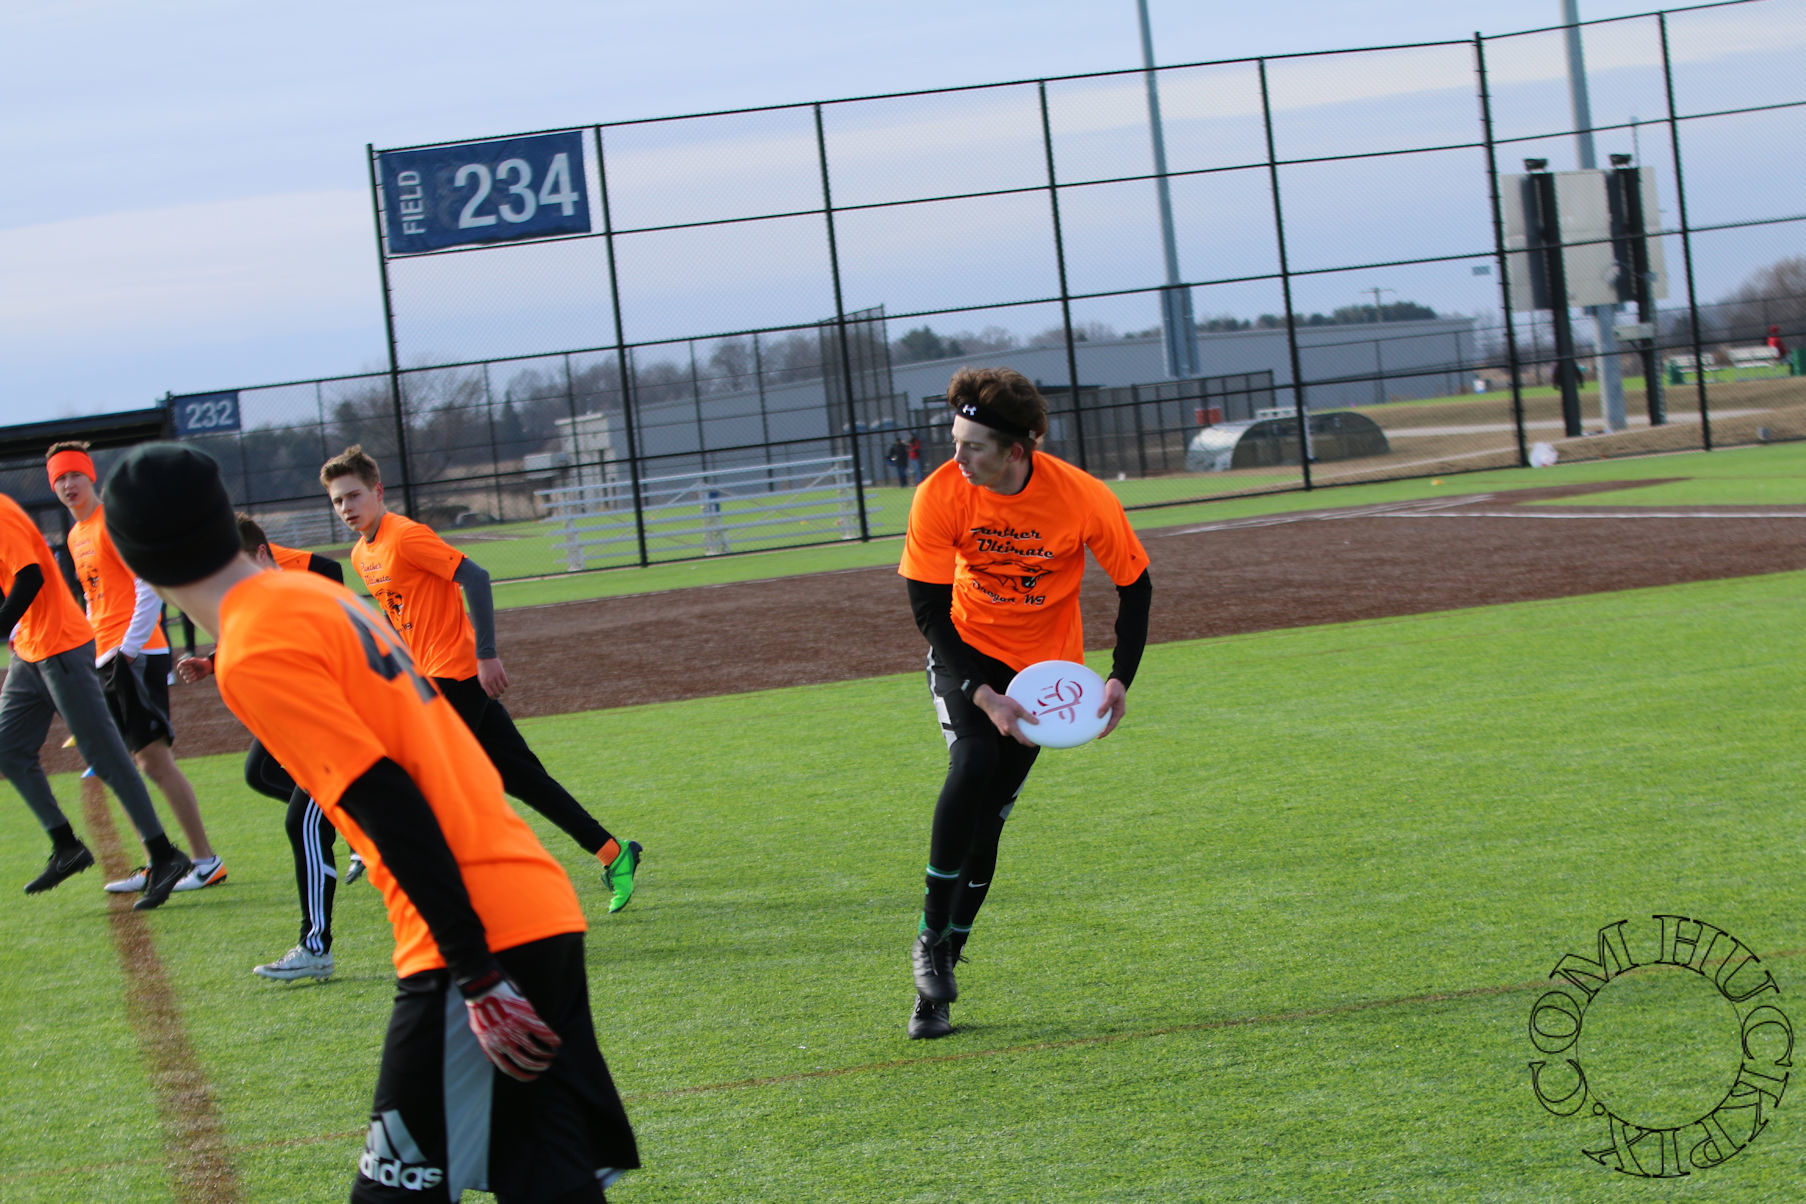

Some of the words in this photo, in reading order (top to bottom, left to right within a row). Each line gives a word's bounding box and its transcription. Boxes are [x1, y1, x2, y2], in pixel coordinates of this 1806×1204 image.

[397, 170, 426, 235] FIELD
[454, 152, 579, 229] 234
[185, 400, 234, 430] 232
[970, 526, 1042, 540] Panther
[977, 538, 1054, 559] Ultimate
